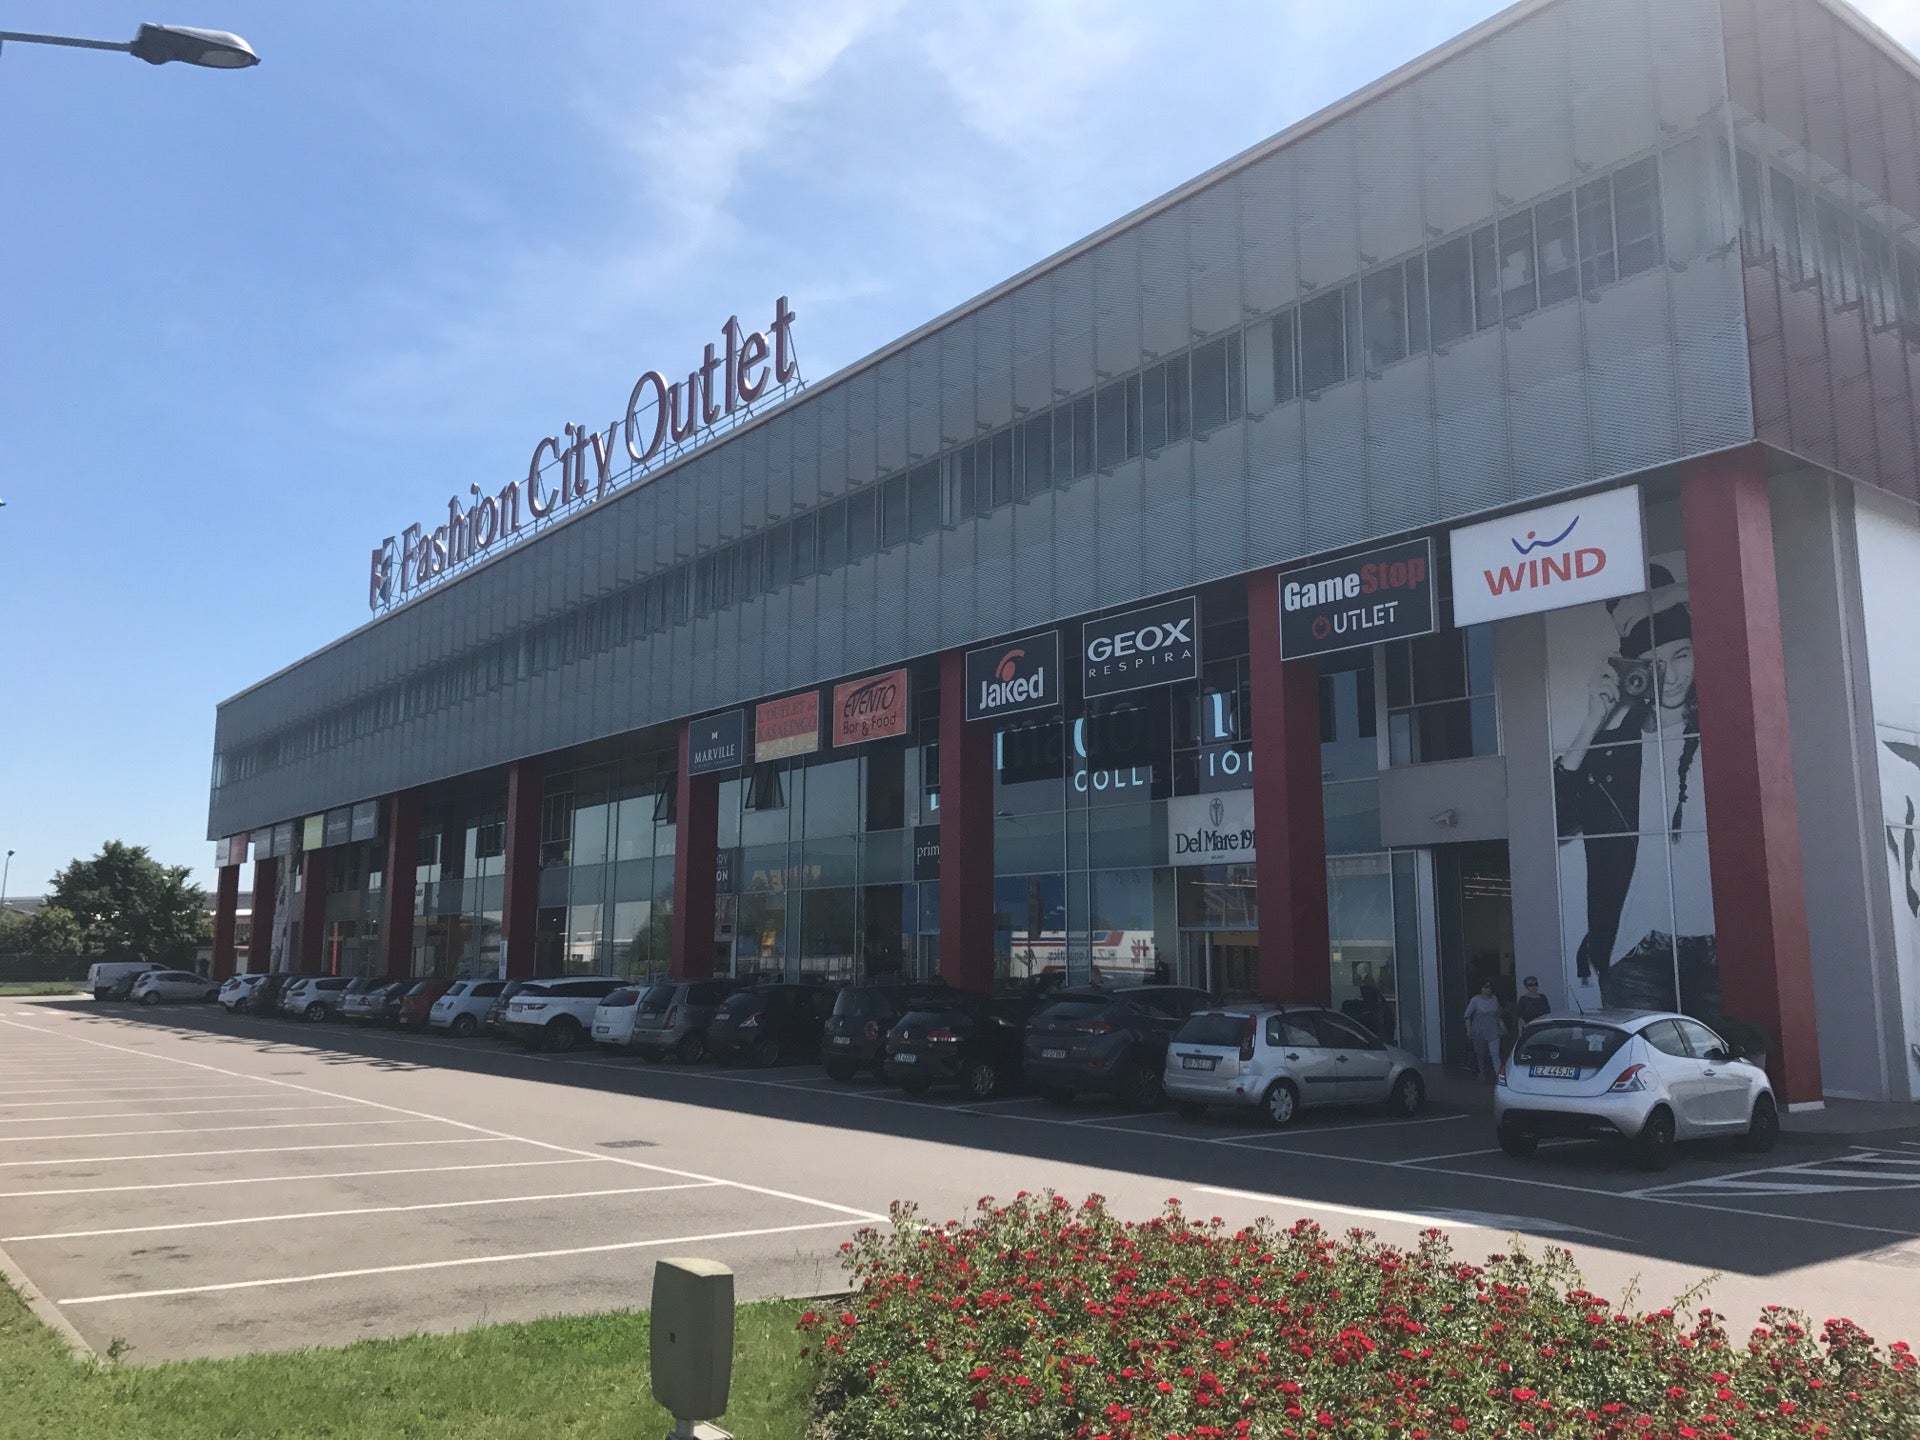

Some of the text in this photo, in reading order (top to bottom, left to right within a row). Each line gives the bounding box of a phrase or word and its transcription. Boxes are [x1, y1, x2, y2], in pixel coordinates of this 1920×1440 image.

[401, 295, 796, 592] Fashion City Outlet
[1284, 556, 1426, 611] GameStop
[1483, 546, 1607, 596] WIND
[1087, 618, 1191, 662] GEOX
[1088, 649, 1192, 678] RESPIRA
[844, 680, 896, 717] EVENTO
[979, 667, 1044, 710] Jaked
[843, 720, 858, 735] Bar
[862, 721, 869, 736] &
[695, 744, 735, 763] MARVILLE
[917, 841, 940, 865] prim
[1176, 828, 1202, 854] Del
[1204, 830, 1239, 851] Mare
[716, 869, 729, 882] ON
